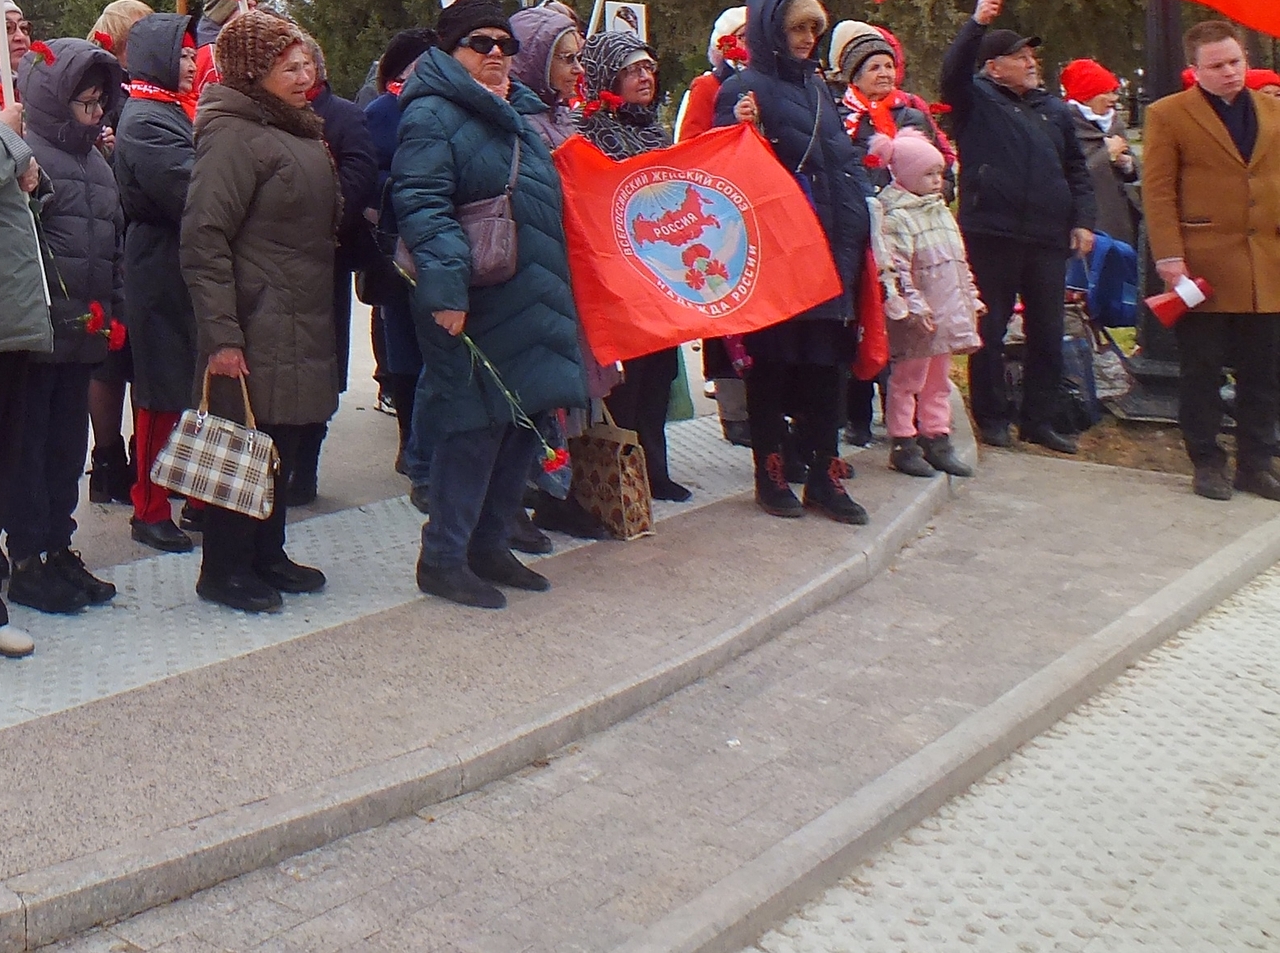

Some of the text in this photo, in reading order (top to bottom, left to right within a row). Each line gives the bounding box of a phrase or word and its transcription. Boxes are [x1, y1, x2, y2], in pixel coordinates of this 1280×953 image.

[615, 172, 649, 256] ВСЕРОССИЙСКИЙ
[716, 181, 749, 212] СОЮЗ
[653, 212, 698, 238] РОССИЯ
[731, 244, 757, 302] РОССИИ
